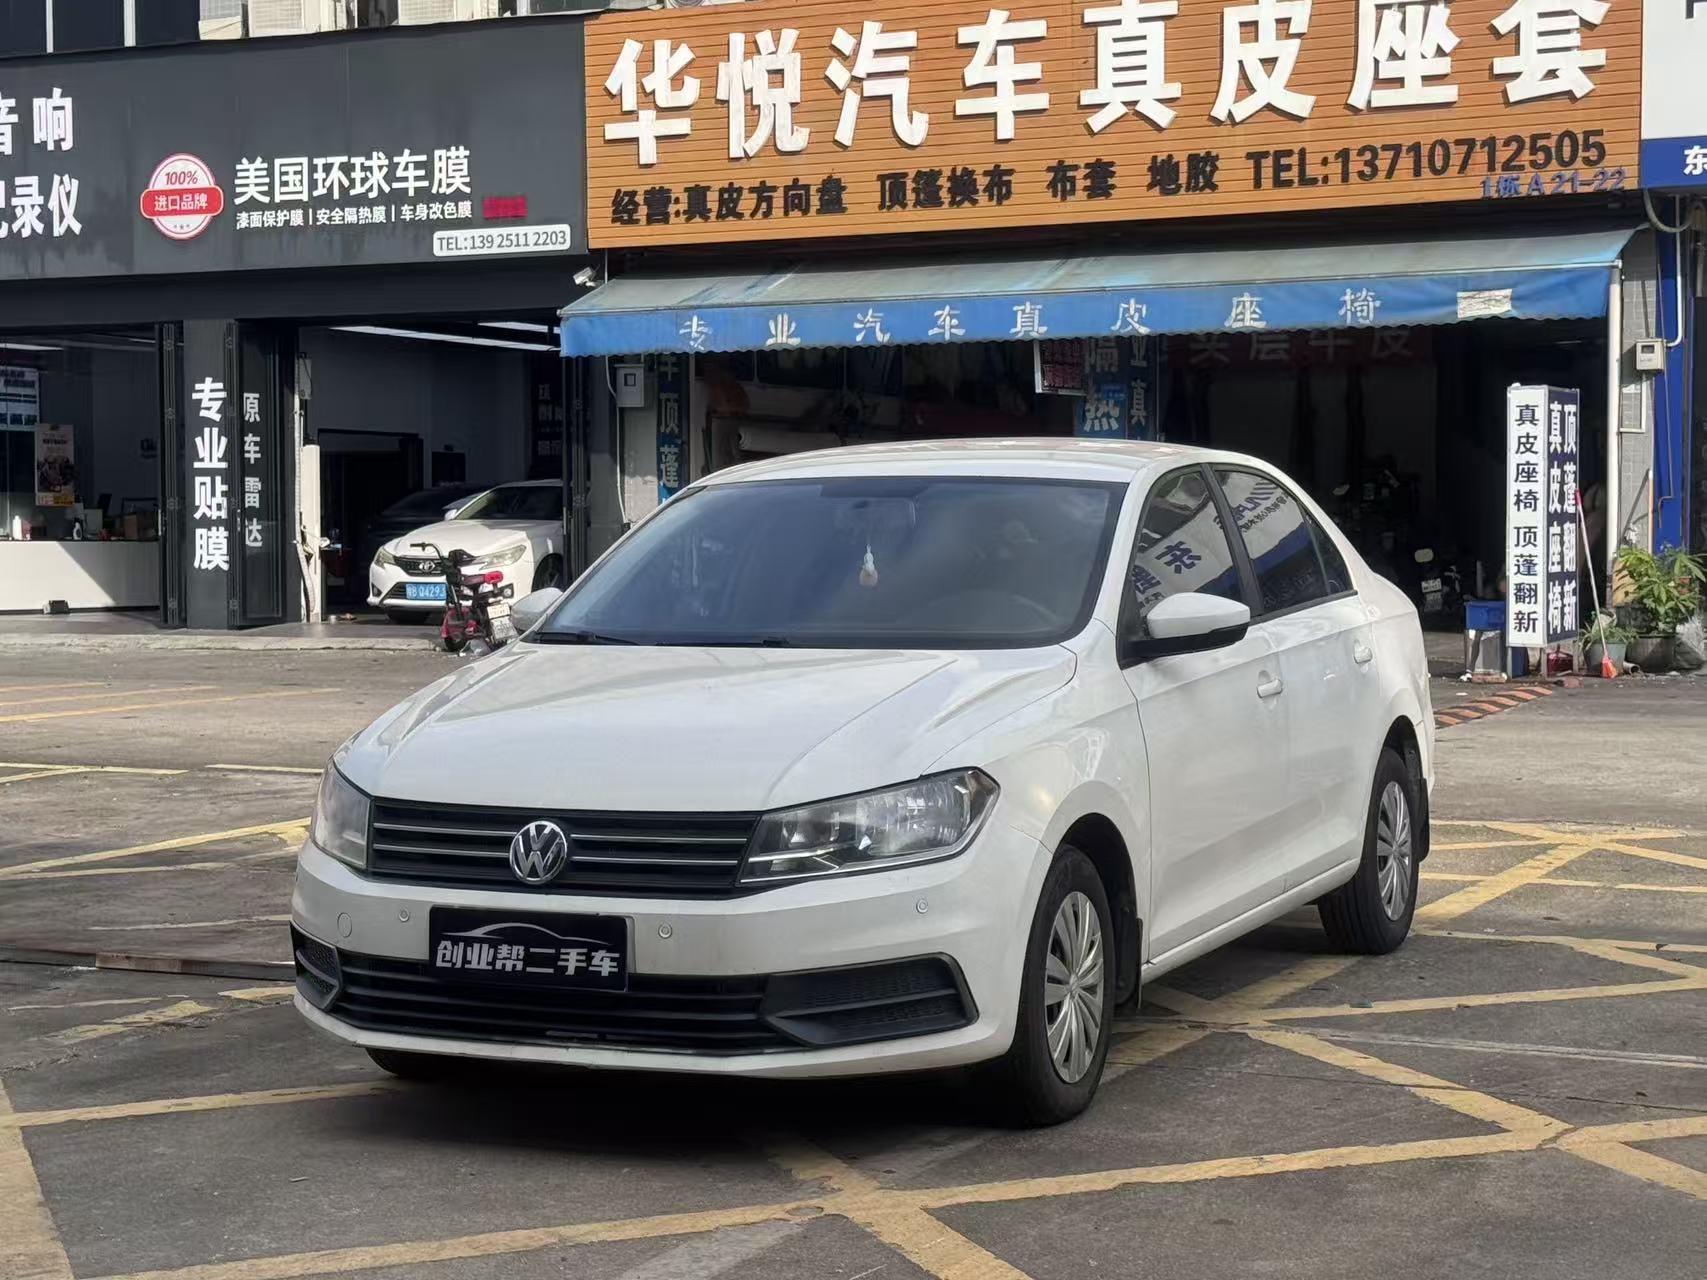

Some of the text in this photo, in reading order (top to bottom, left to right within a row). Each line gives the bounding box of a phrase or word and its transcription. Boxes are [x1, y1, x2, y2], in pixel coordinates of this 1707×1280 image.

[603, 0, 1612, 165] 华悦汽车真皮座套
[165, 171, 198, 186] 100%
[234, 146, 471, 206] 美国环球车膜
[1045, 158, 1117, 201] 布套
[1147, 153, 1219, 195] 地胶
[1246, 129, 1606, 190] TEL:13710712505
[154, 194, 208, 211] 进口品牌
[236, 208, 304, 230] 漆面保护膜
[316, 204, 387, 226] 安全隔热膜
[401, 200, 473, 222] 车身改色膜
[679, 287, 1380, 352] 专业汽车真皮座椅
[192, 377, 229, 571] 专业贴膜
[243, 393, 263, 547] 原车雷达
[1514, 404, 1540, 634] 真皮座椅 顶蓬翻新
[1548, 401, 1562, 635] 真皮座椅
[436, 940, 620, 976] 创业帮二手车
